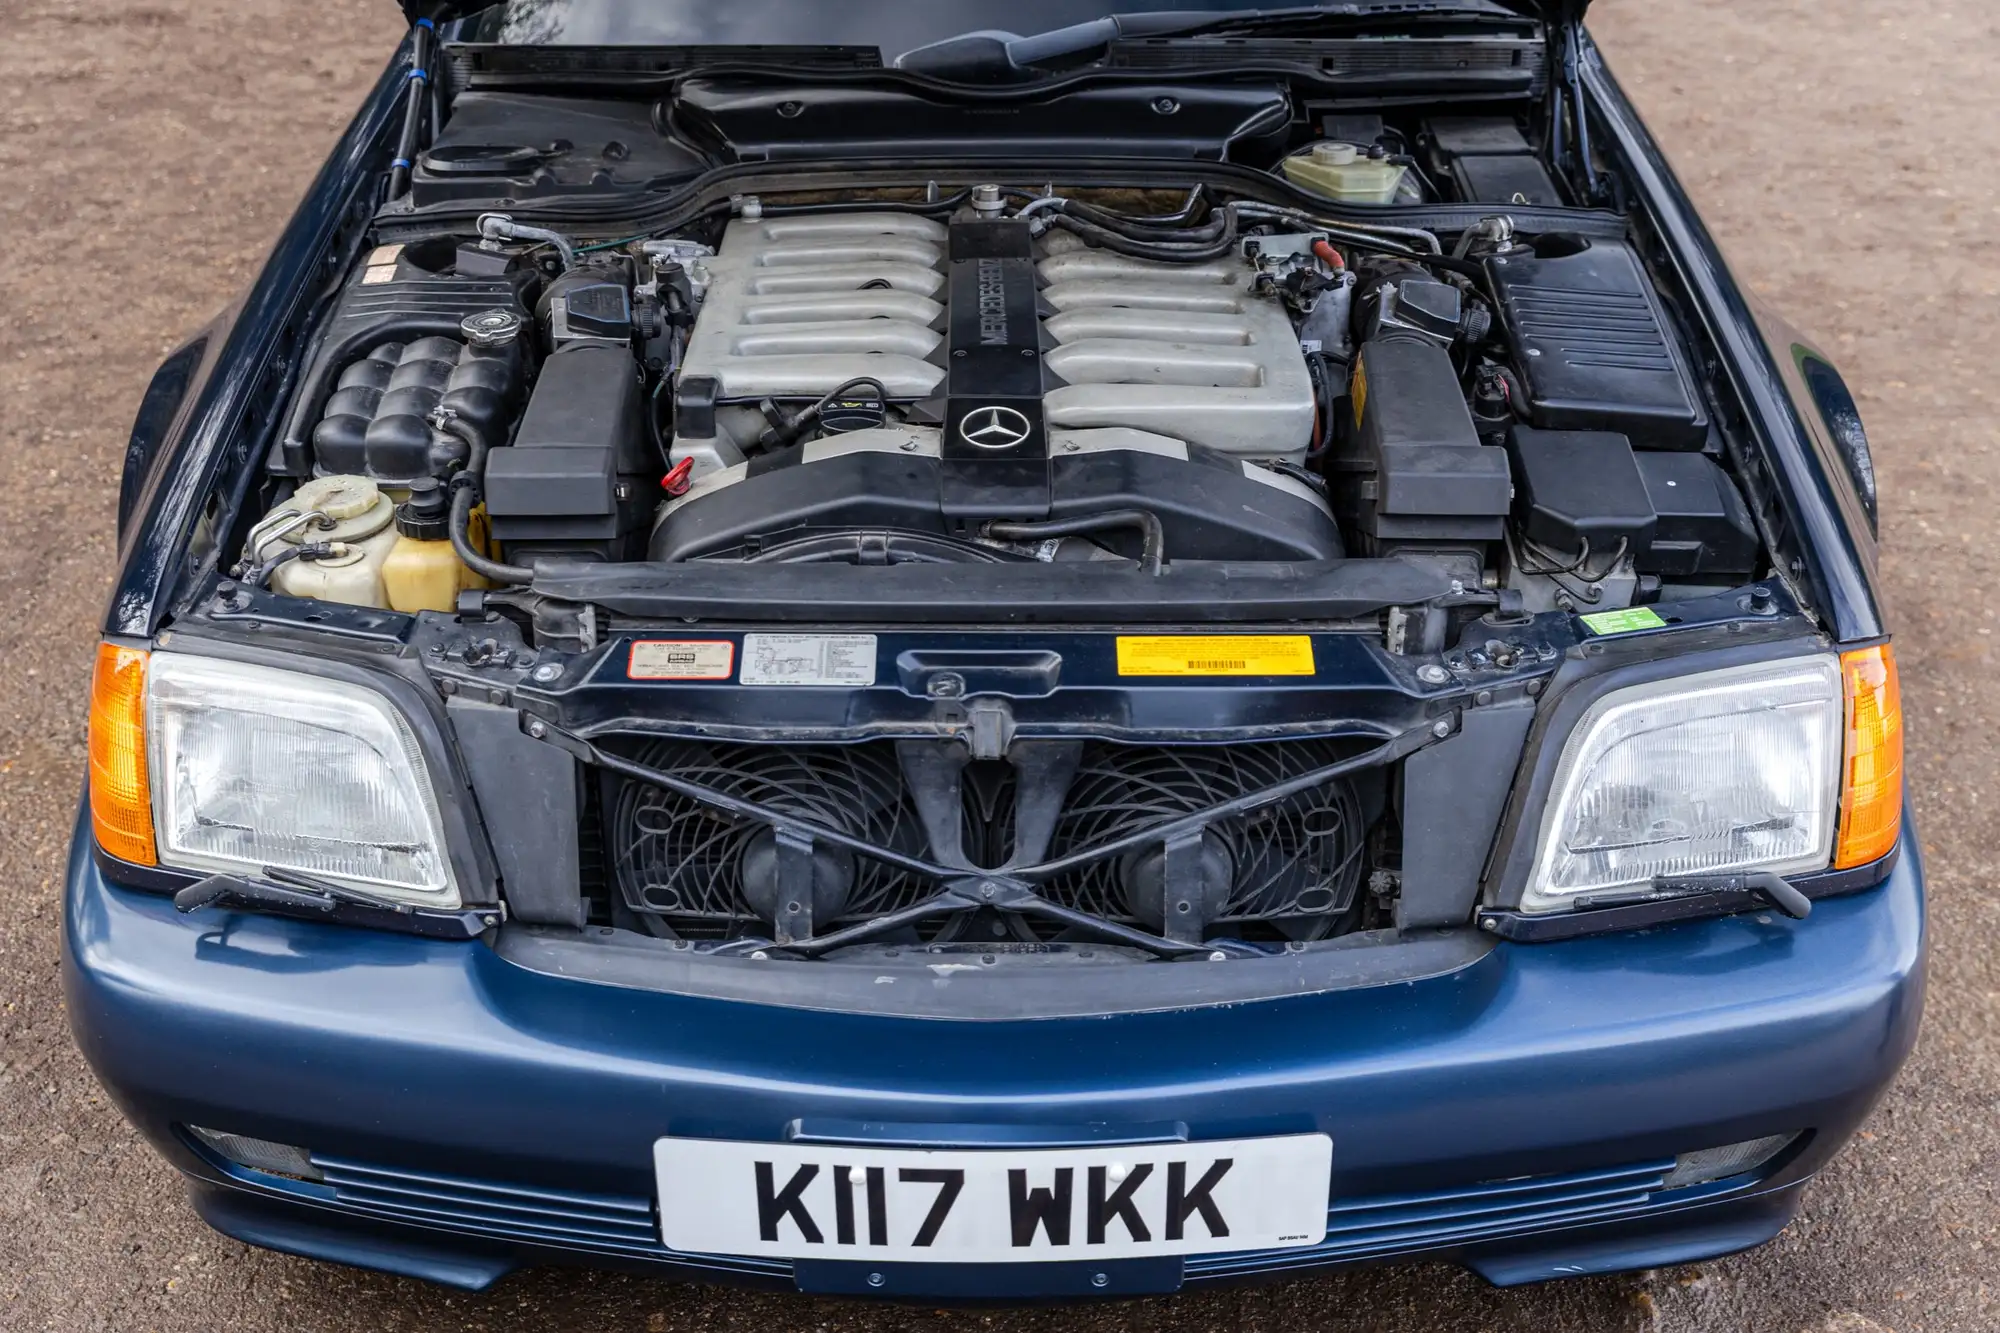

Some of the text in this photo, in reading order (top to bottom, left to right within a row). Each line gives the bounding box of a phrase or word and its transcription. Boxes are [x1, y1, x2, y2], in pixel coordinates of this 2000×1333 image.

[978, 258, 1008, 345] MERCEDES-BENZ
[754, 1158, 1233, 1247] K117 WKK
